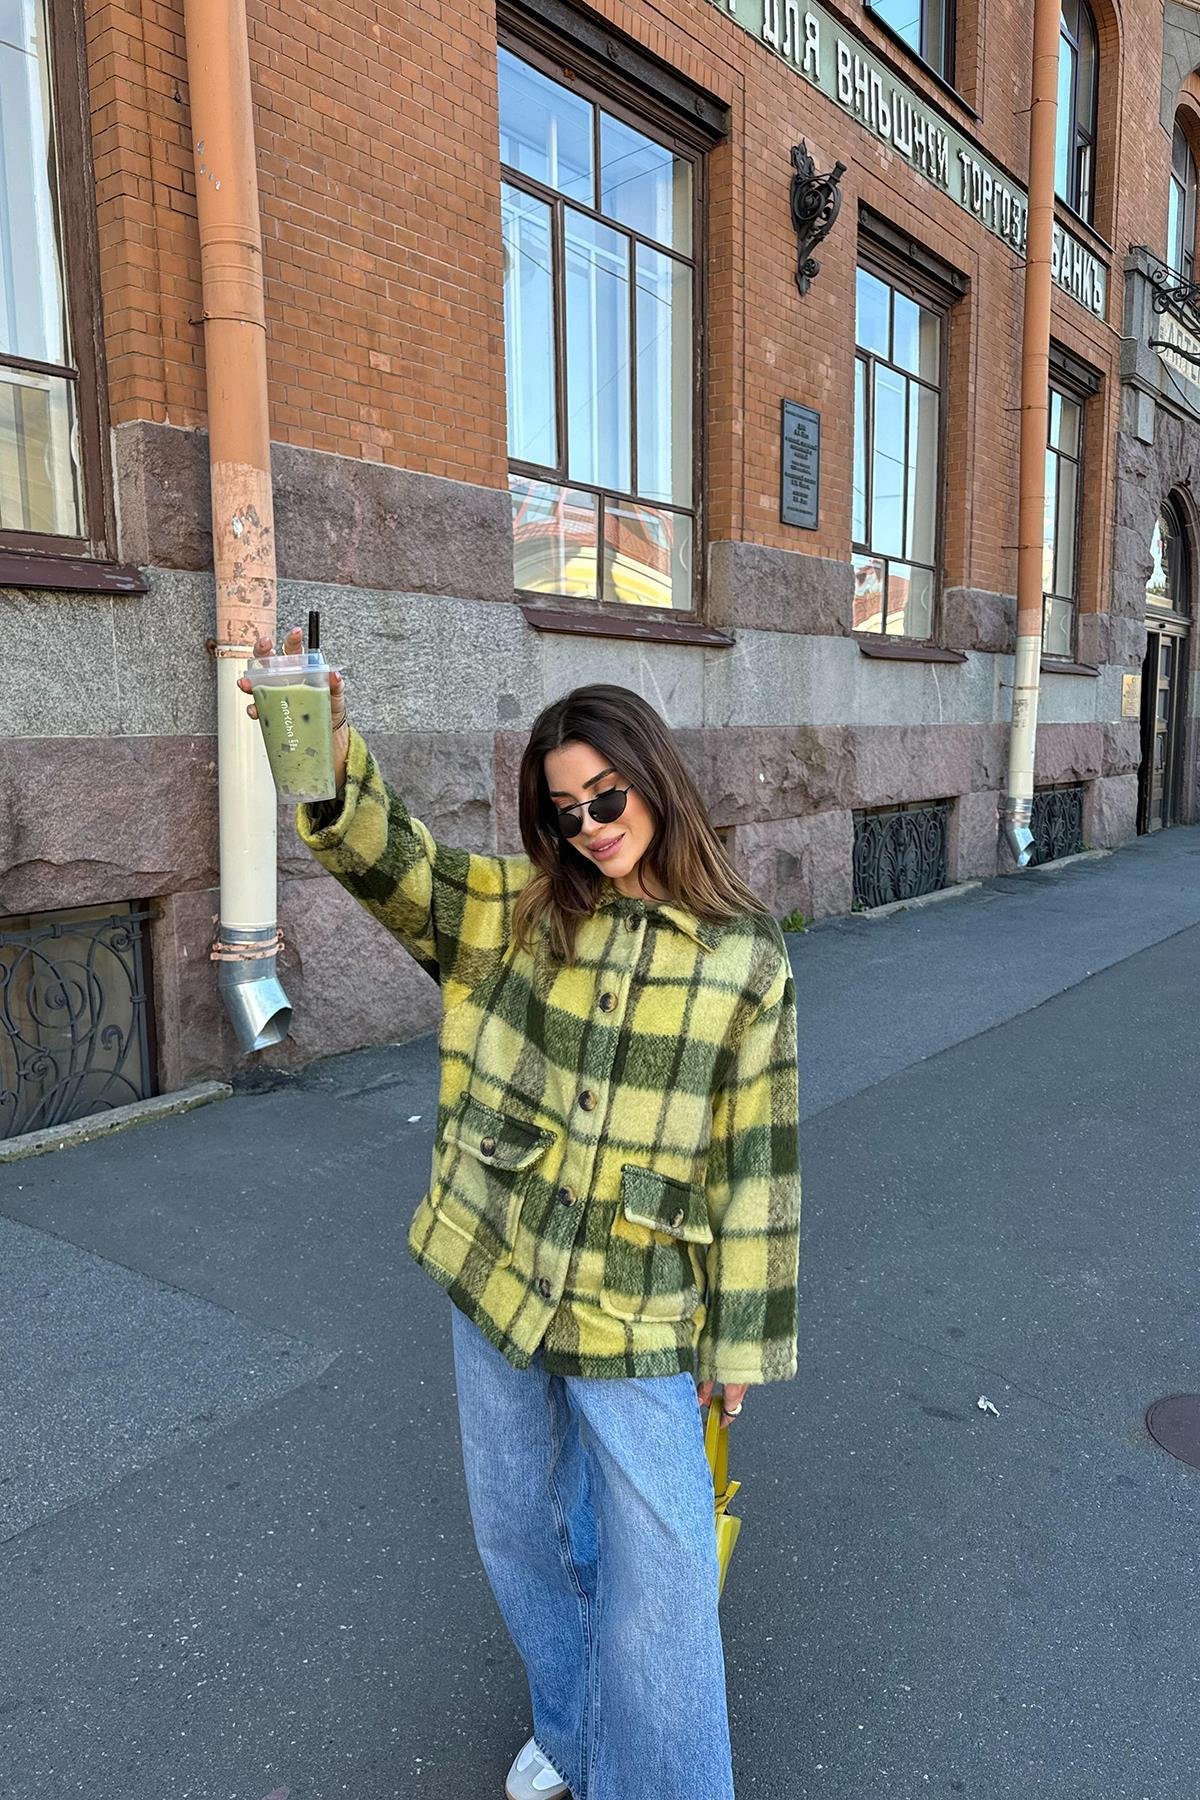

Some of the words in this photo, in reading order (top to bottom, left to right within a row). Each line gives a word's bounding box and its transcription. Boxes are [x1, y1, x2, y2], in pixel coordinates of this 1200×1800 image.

[763, 0, 820, 80] ДЛЯ
[958, 150, 1028, 250] ТОРГОВ
[1165, 322, 1200, 384] АПТЕ
